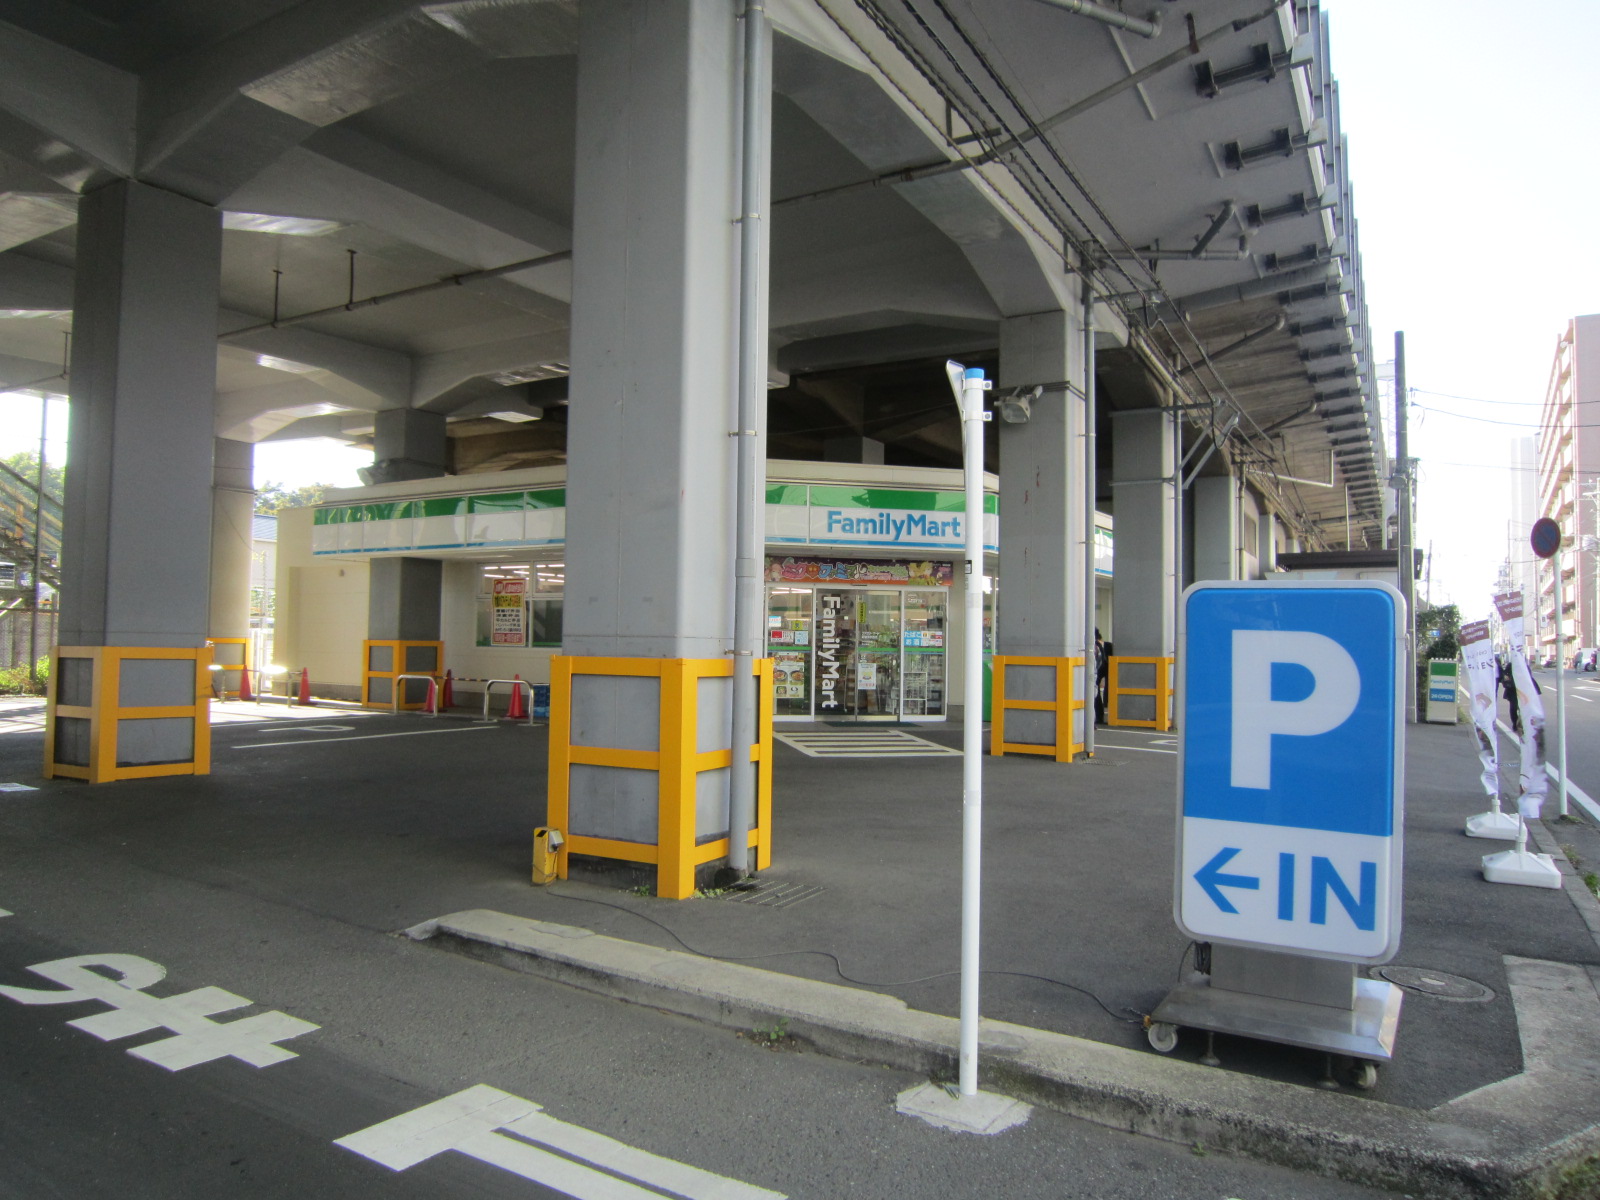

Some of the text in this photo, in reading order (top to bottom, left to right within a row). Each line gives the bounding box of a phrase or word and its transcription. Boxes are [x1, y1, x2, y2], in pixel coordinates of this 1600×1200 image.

[827, 510, 961, 541] FamilyMart
[818, 596, 841, 709] FamilyMart
[1230, 629, 1361, 790] P
[1277, 852, 1377, 932] IN
